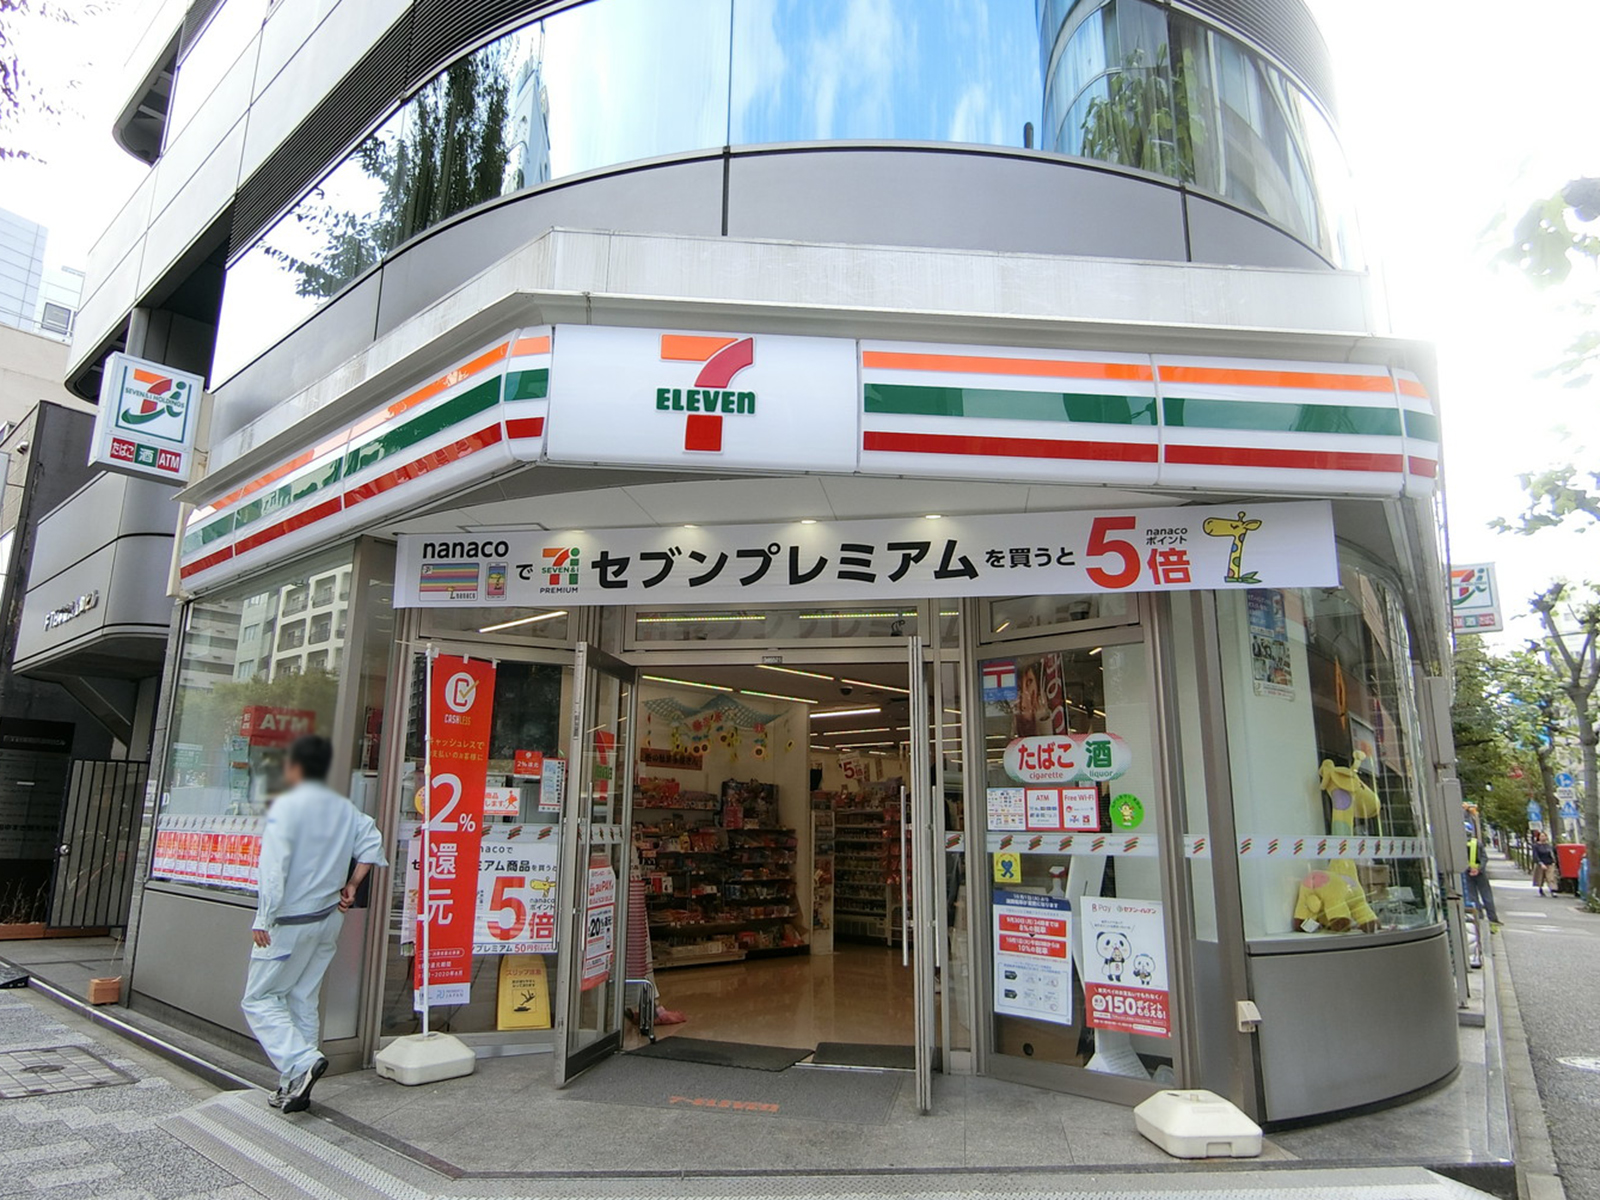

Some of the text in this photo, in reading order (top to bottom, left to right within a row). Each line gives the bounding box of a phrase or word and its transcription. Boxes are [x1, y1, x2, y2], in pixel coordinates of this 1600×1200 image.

[153, 394, 185, 409] HOLDINGS
[112, 441, 180, 469] たばこ 酒 ATM
[1146, 527, 1188, 536] nanaco
[1146, 535, 1187, 545] ポイント
[422, 541, 509, 559] nanaco
[591, 516, 1141, 589] セブンプレミアム を買うと 5
[516, 564, 534, 580] で
[1147, 547, 1191, 585] 倍
[260, 713, 309, 734] ATM
[444, 714, 471, 726] CASHLESS
[431, 750, 483, 761] 支払いのお客様に
[1018, 740, 1112, 770] たばこ 酒
[843, 761, 855, 779] 5
[1029, 770, 1114, 780] cigarette liquor
[487, 876, 528, 942] 5
[528, 912, 555, 940] 倍
[1105, 994, 1137, 1016] 150
[1136, 1000, 1163, 1010] ポイント
